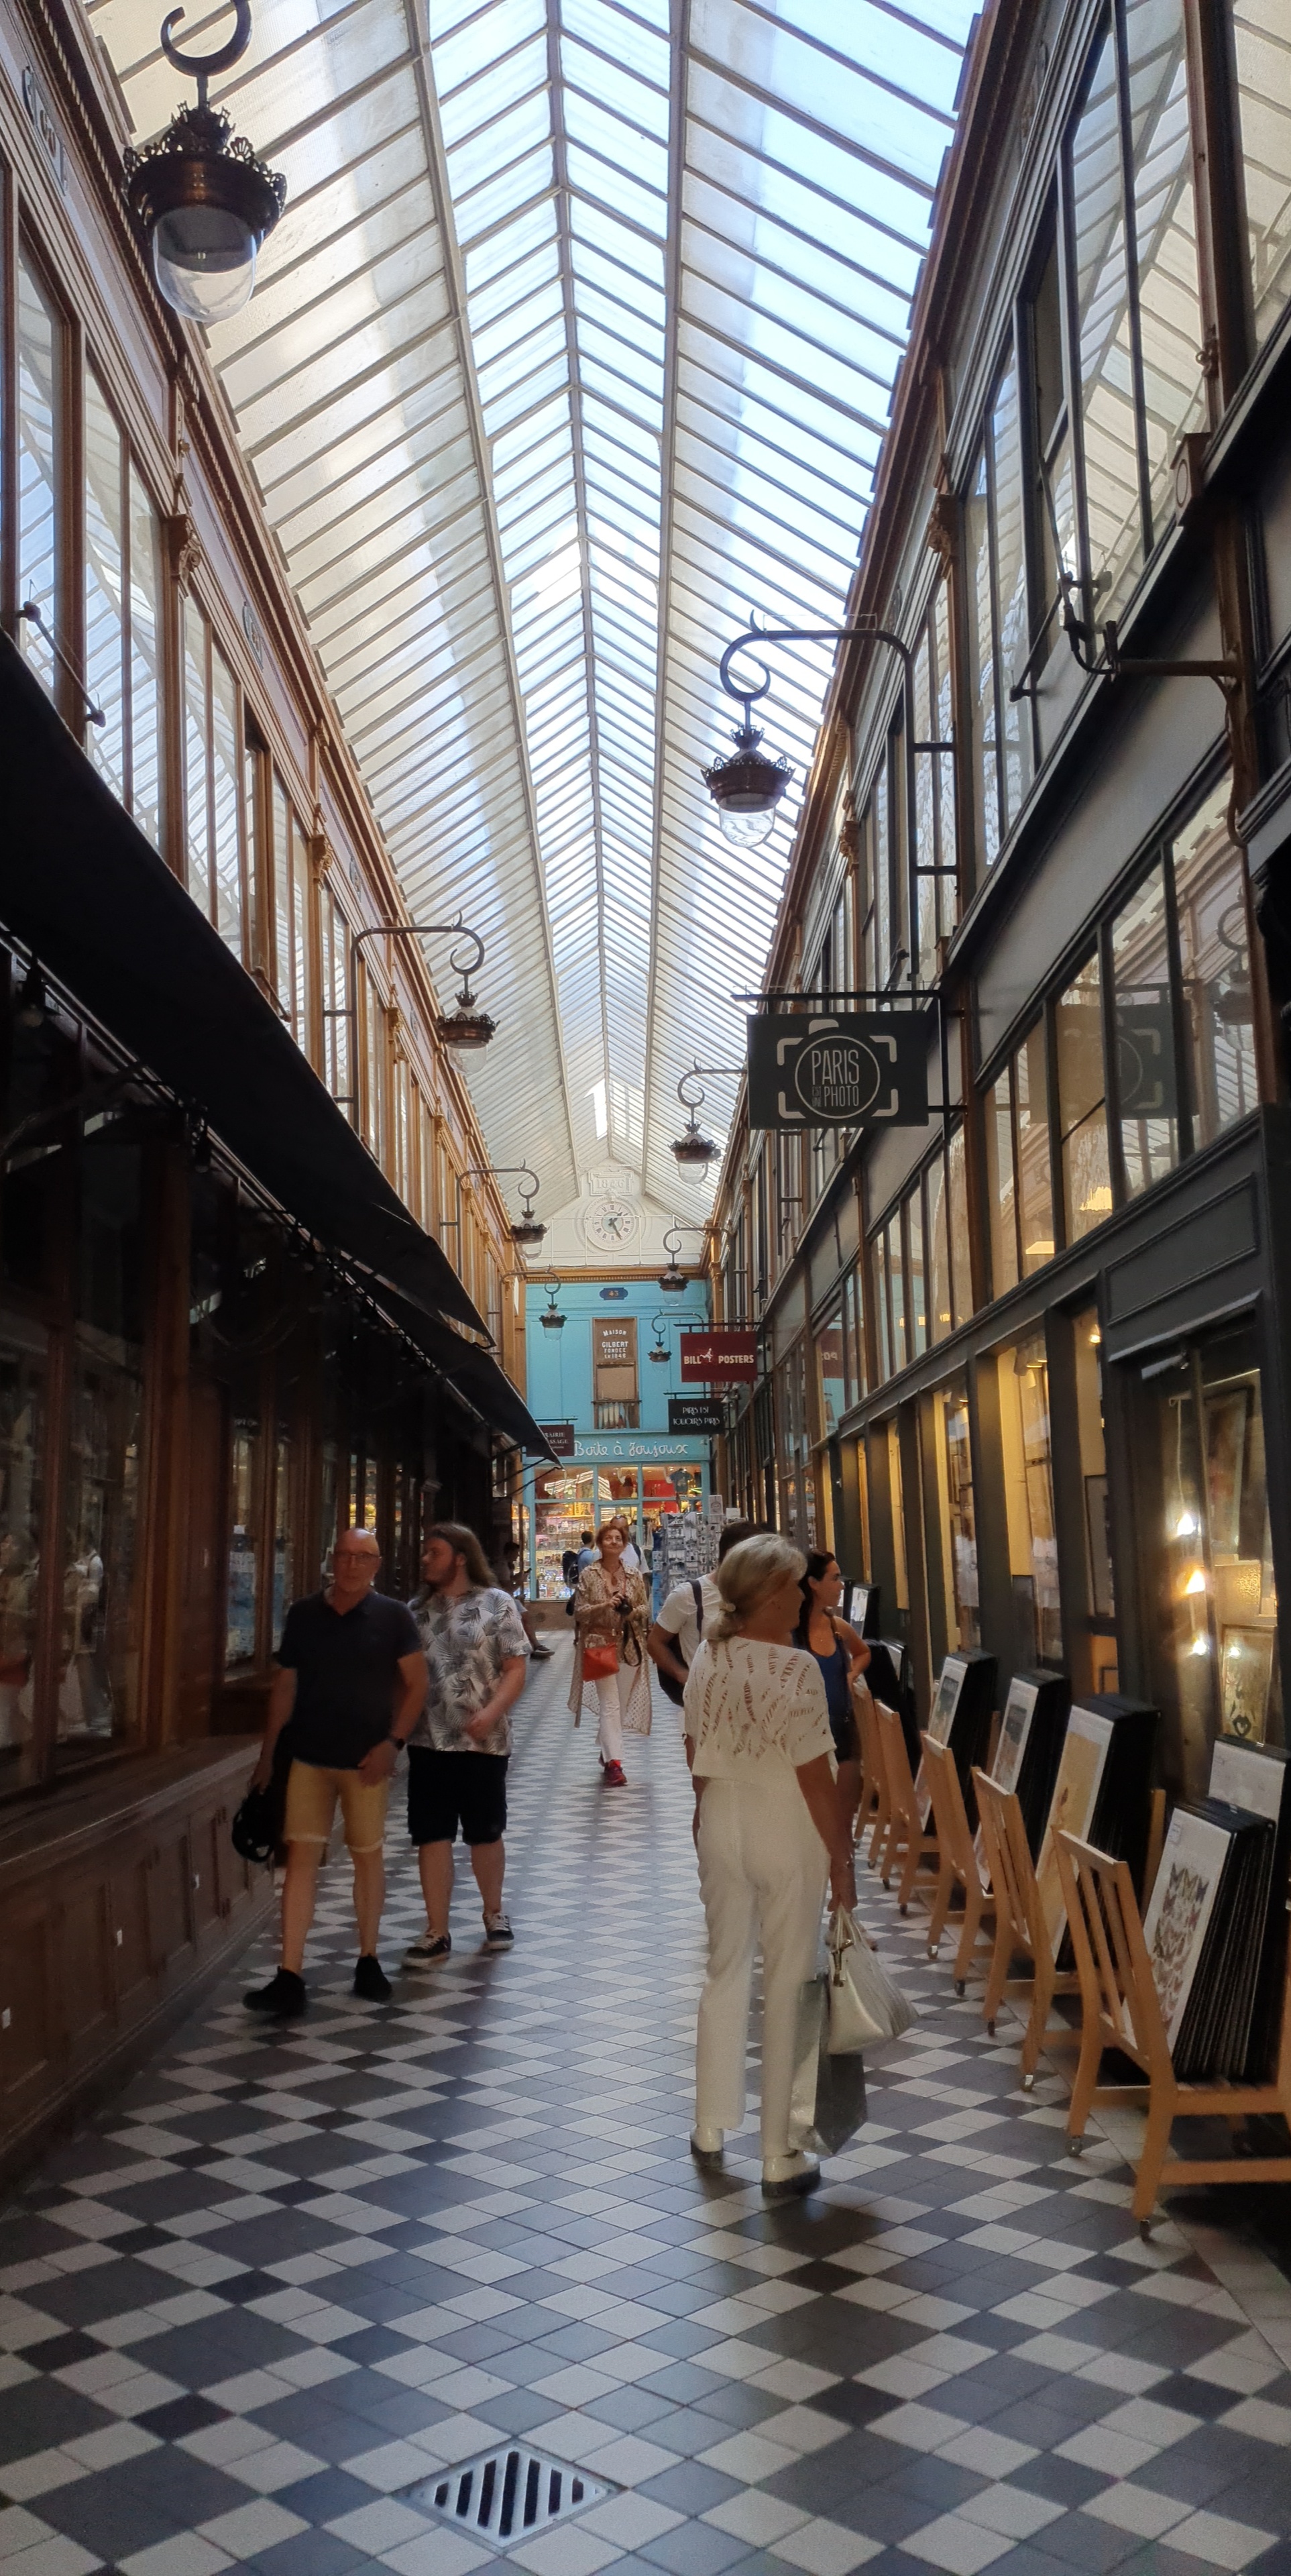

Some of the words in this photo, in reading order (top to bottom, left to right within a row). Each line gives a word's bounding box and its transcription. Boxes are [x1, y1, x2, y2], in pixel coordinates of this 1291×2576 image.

[811, 1049, 859, 1085] PARIS
[824, 1085, 859, 1107] PHOTO
[684, 1356, 701, 1364] BILL
[718, 1355, 754, 1364] POSTERS
[682, 1407, 698, 1415] PARIS
[704, 1417, 720, 1426] PARIS
[613, 1441, 624, 1456] à
[628, 1441, 689, 1458] Joujoux
